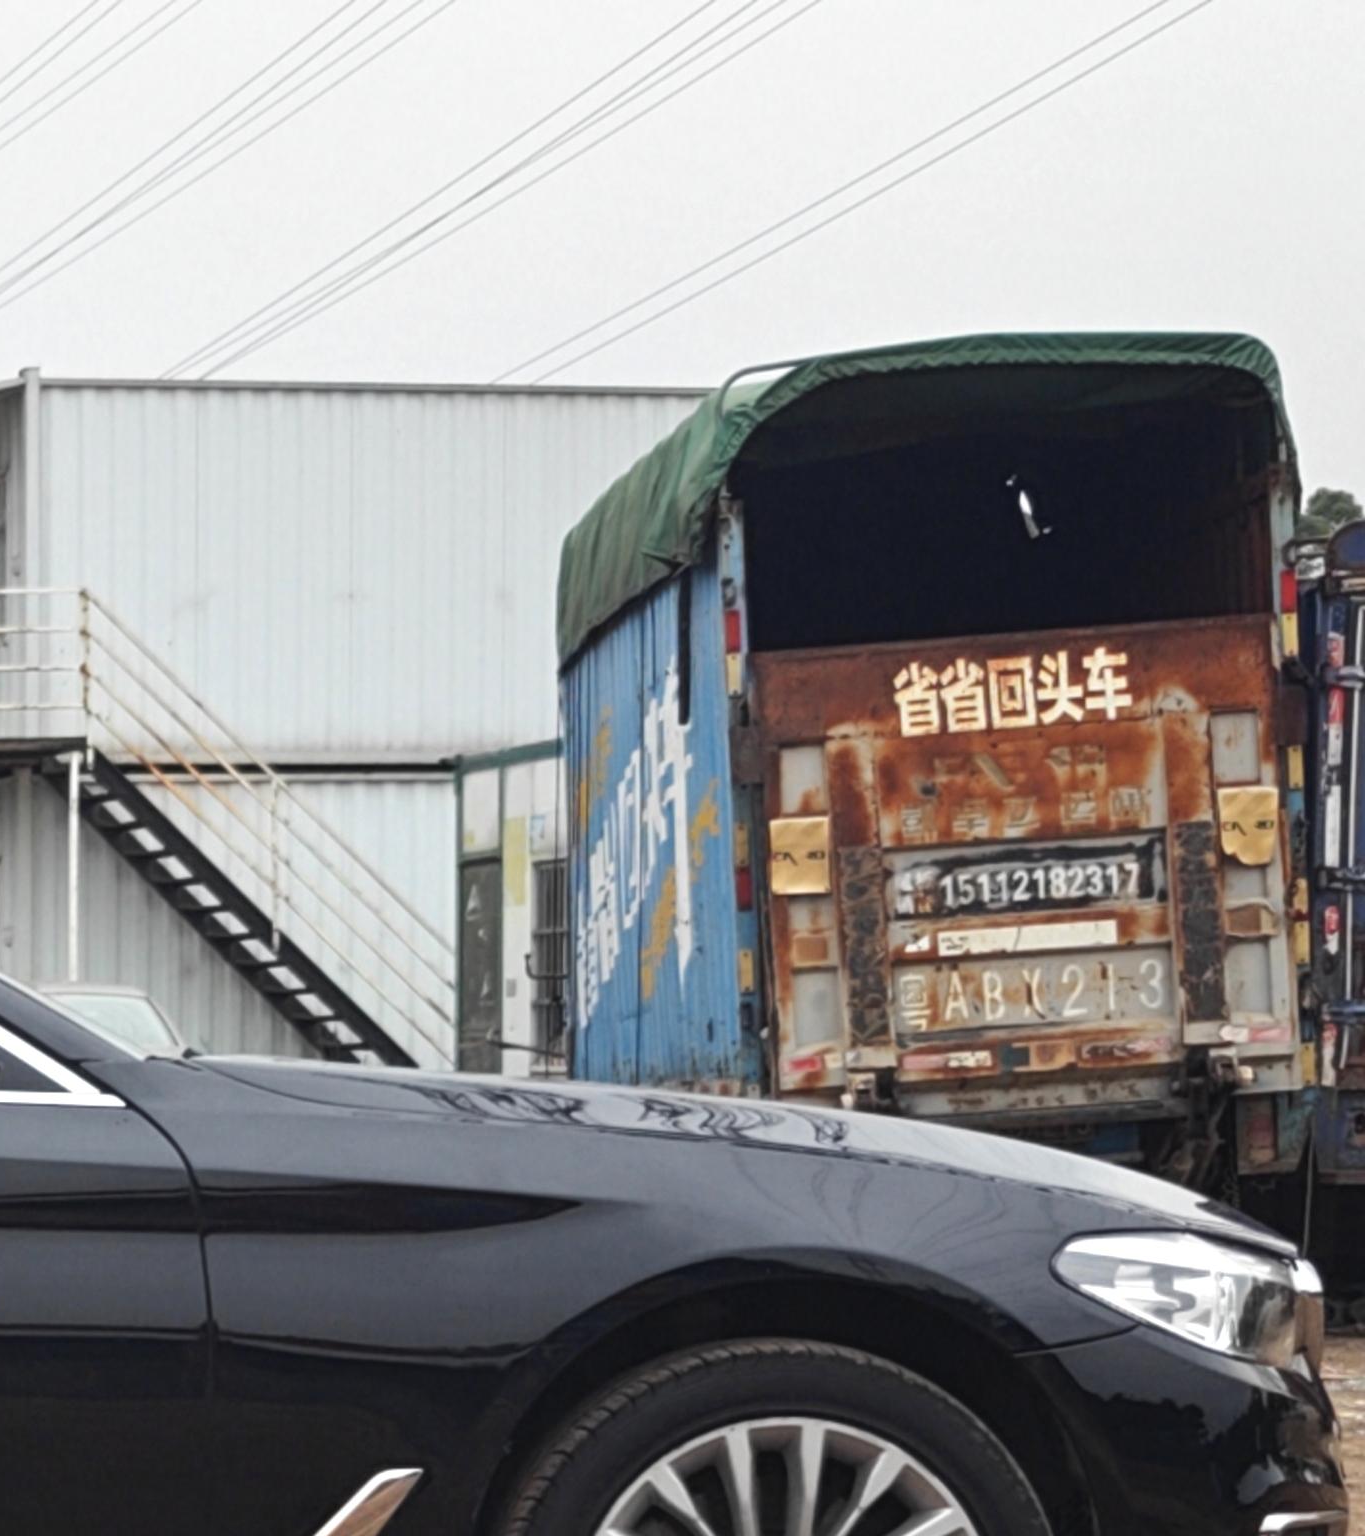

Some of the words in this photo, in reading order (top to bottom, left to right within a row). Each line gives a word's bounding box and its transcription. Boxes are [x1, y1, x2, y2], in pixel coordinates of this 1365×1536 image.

[893, 646, 1133, 737] 省省回头车
